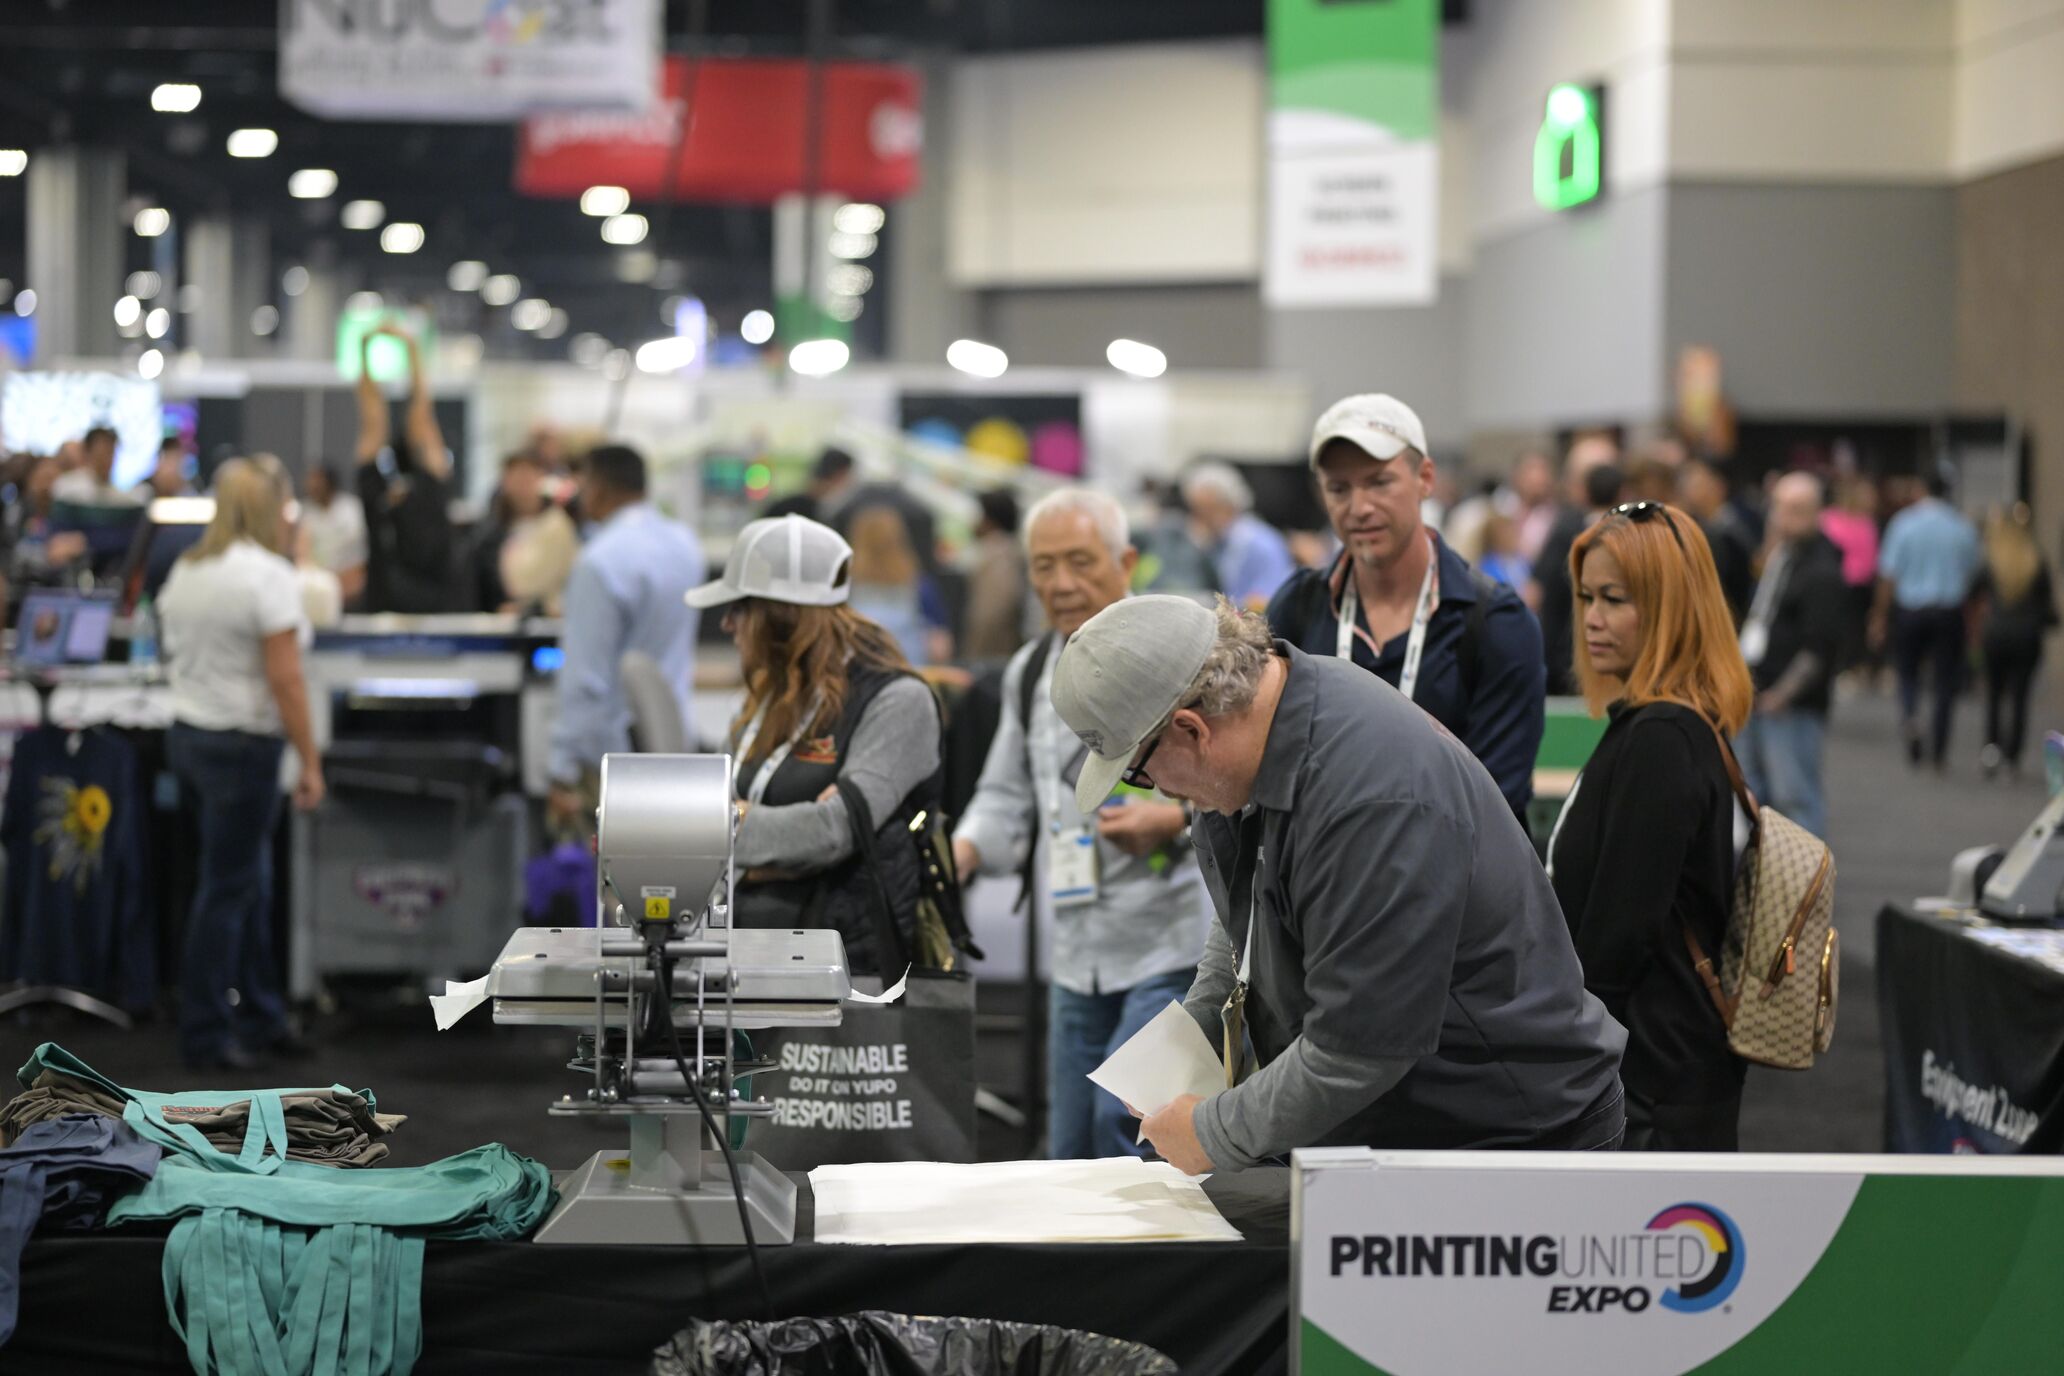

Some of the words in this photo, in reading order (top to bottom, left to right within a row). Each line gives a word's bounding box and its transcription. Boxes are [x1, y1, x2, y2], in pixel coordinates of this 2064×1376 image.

[789, 1076, 813, 1093] DO
[814, 1078, 830, 1094] IT
[831, 1079, 850, 1095] ON
[852, 1078, 897, 1094] YUPO
[771, 1097, 913, 1130] RESPONSIBLE
[1546, 1285, 1652, 1314] EXPO
